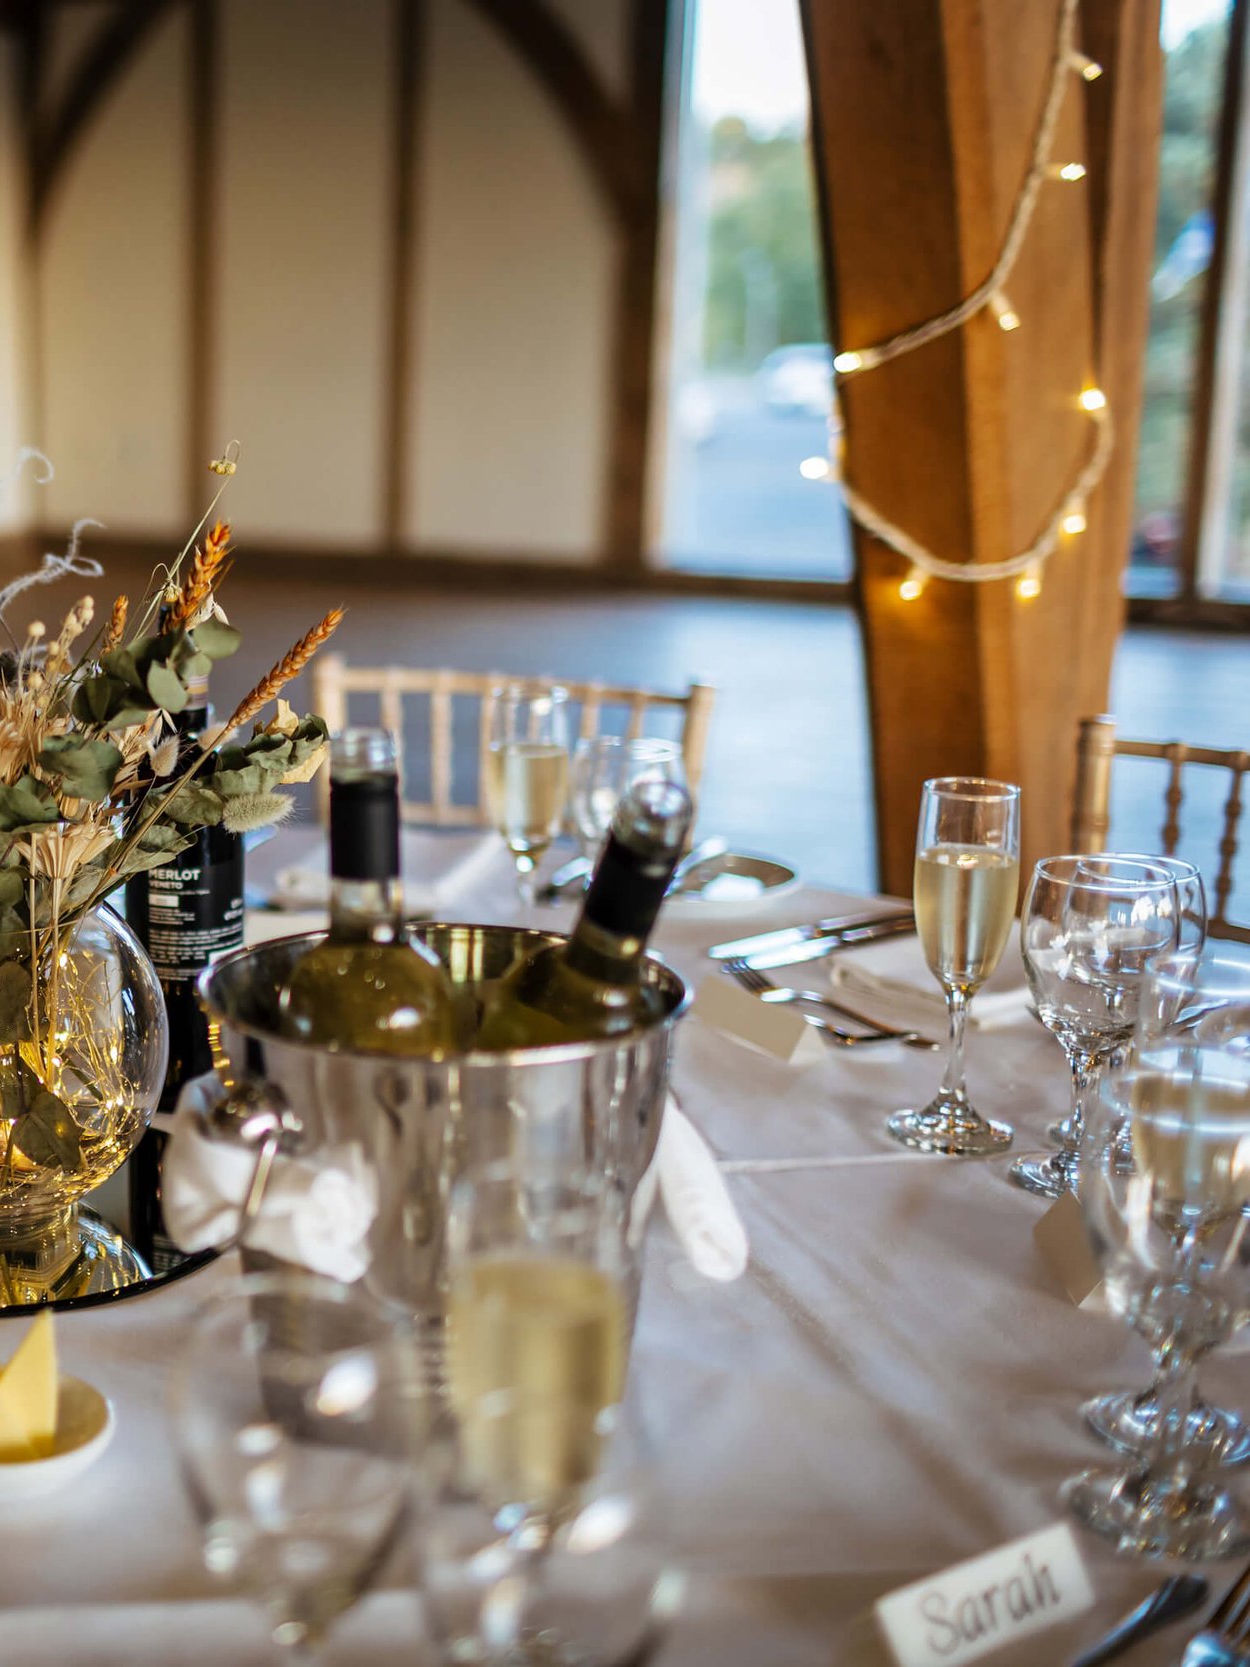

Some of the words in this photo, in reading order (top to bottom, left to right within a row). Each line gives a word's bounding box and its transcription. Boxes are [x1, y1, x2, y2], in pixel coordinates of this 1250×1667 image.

[149, 869, 200, 881] MERLOT
[150, 881, 183, 889] VENETO
[918, 1552, 1061, 1656] Sarah
